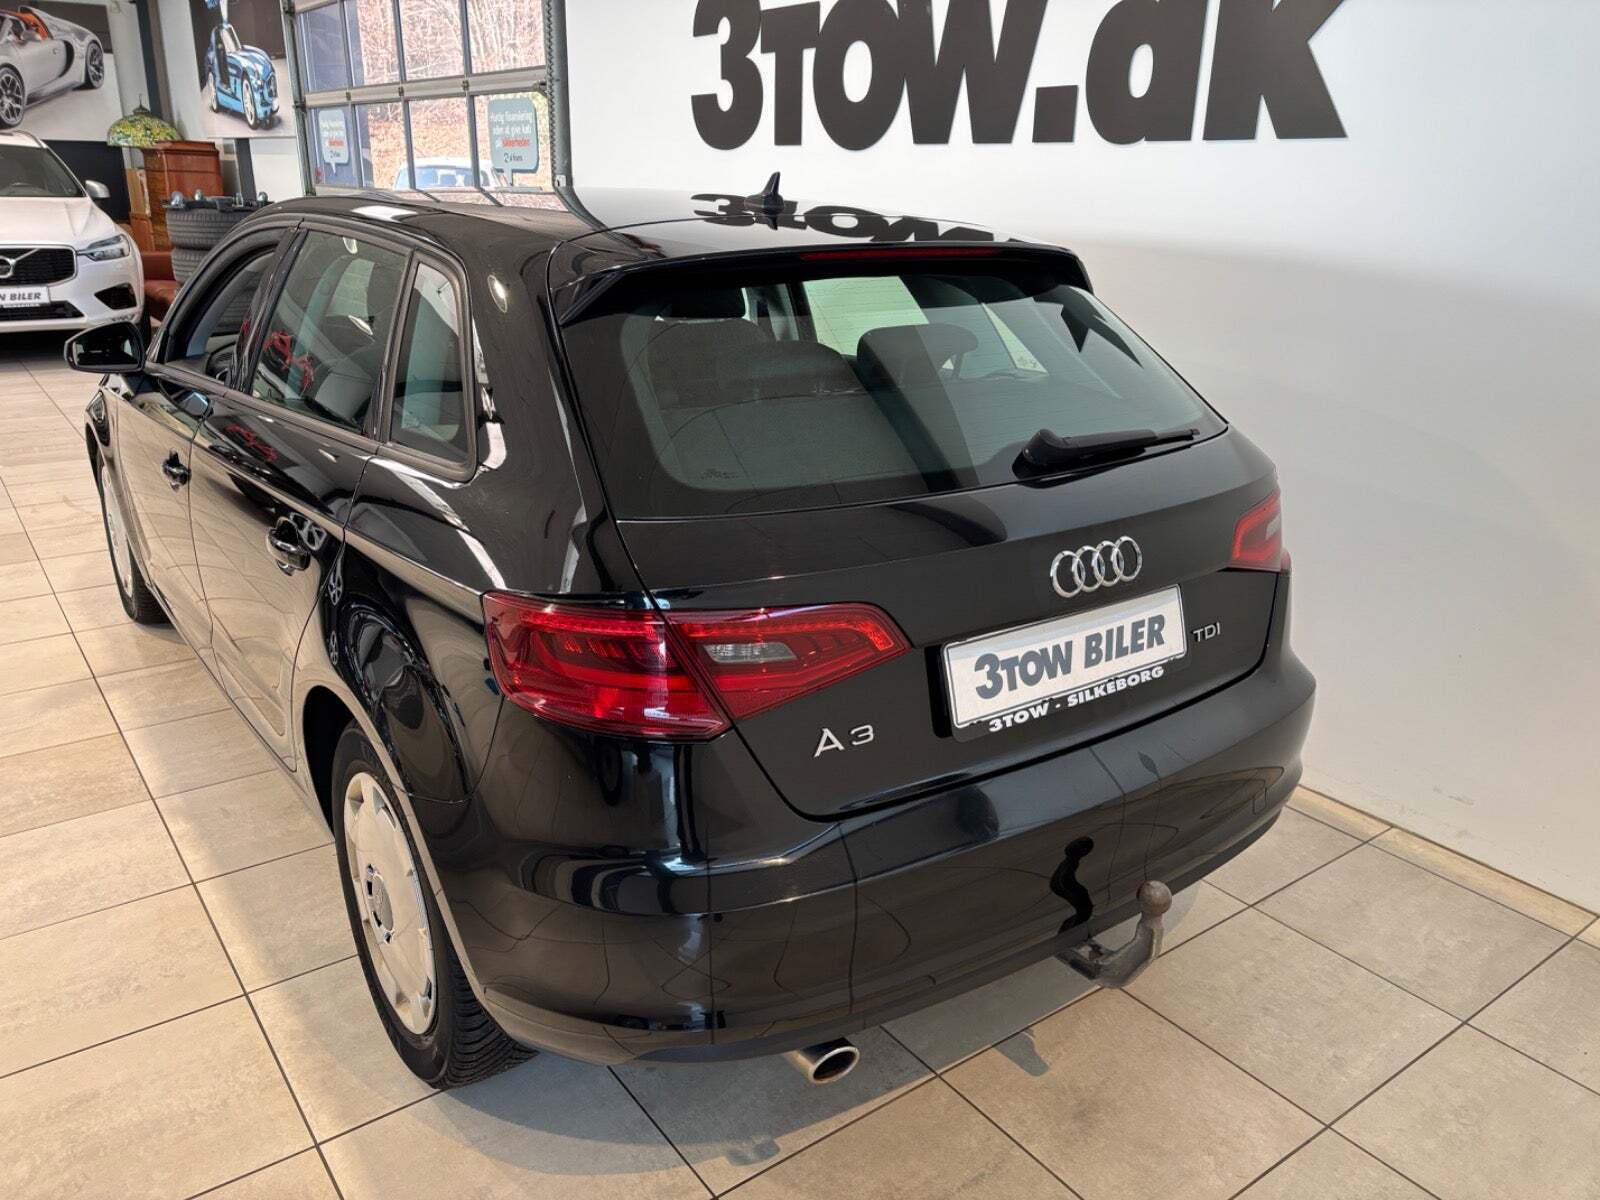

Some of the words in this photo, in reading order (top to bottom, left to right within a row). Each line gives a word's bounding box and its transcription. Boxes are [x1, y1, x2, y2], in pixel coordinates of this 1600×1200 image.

[10, 292, 41, 301] BILER
[1193, 622, 1221, 643] TDI
[974, 640, 1073, 699] 3TOW
[1084, 614, 1165, 668] BILER
[989, 701, 1050, 733] 3TOW
[1066, 665, 1165, 708] SILKEBORG
